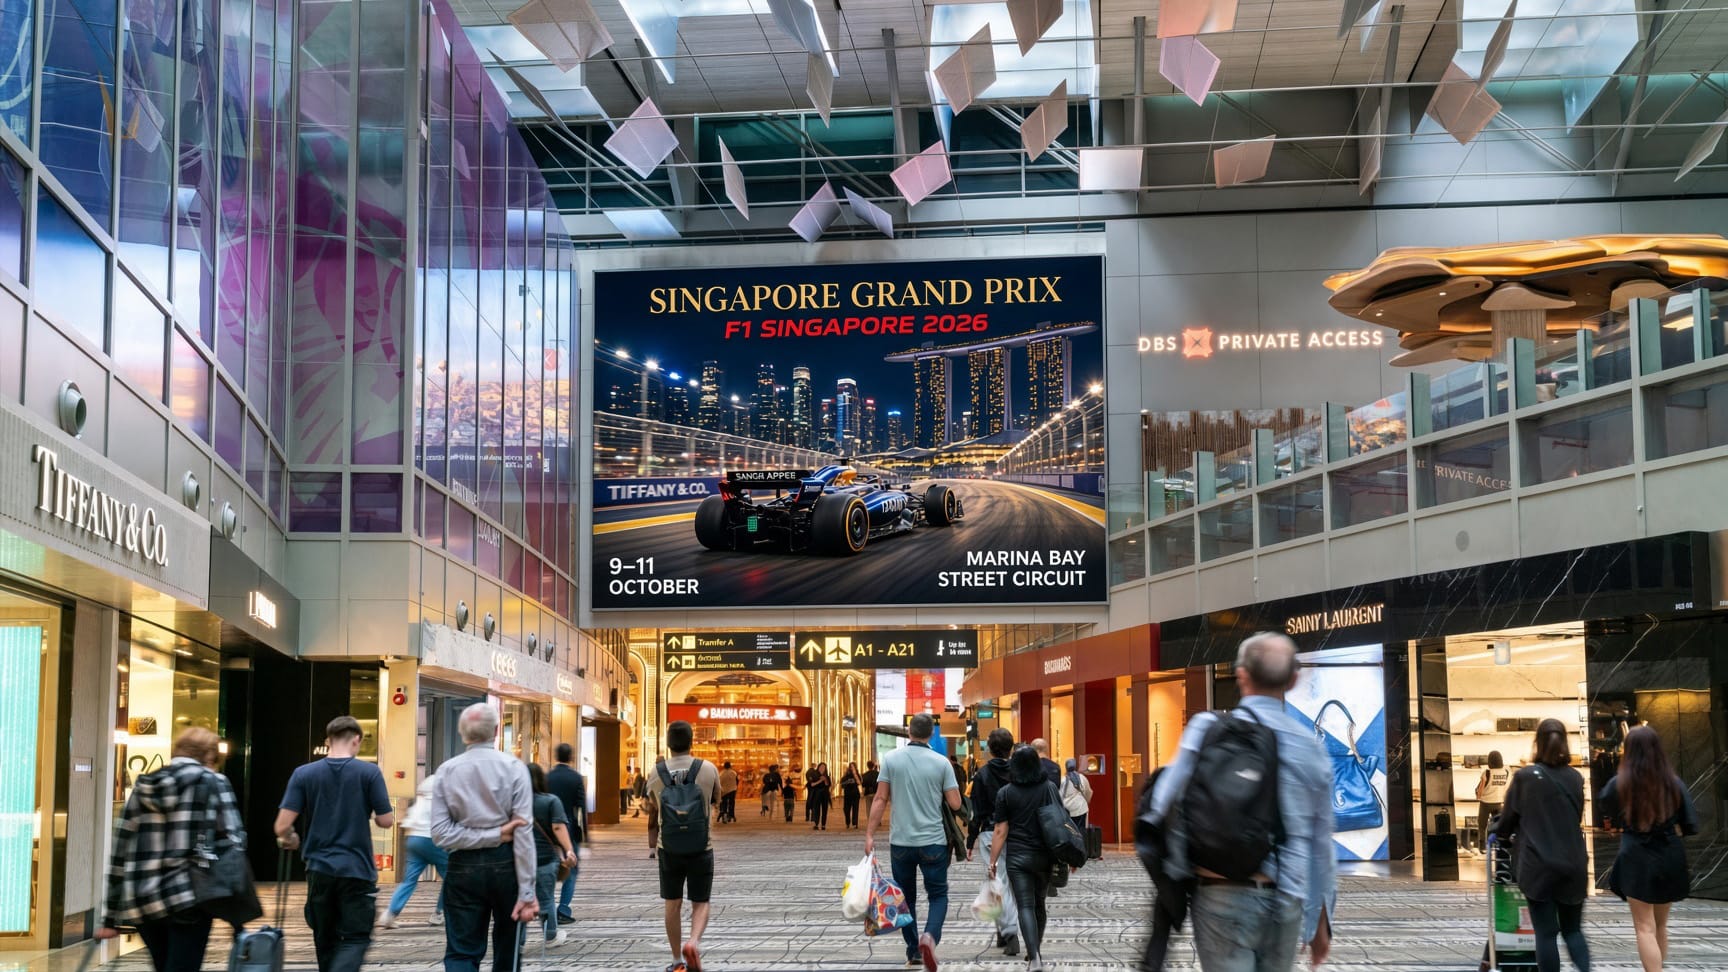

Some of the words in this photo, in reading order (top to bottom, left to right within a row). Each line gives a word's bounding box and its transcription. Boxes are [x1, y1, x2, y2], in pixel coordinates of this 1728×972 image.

[650, 283, 841, 314] SINGAPORE
[851, 279, 973, 308] GRAND
[984, 276, 1063, 305] PRIX
[725, 320, 752, 339] F1
[760, 316, 915, 338] SINGAPORE
[922, 314, 989, 334] 2026
[1138, 336, 1177, 352] DBS
[1218, 332, 1300, 350] PRIVATE
[1308, 330, 1383, 347] ACCESS
[607, 483, 676, 500] TIFFANY
[967, 550, 1043, 566] MARINA
[1049, 550, 1086, 566] BAY
[609, 578, 699, 595] OCTOBER
[938, 571, 1008, 587] STREET
[1012, 570, 1087, 587] CIRCUIT
[1323, 603, 1385, 630] LAURENT
[727, 638, 734, 647] A
[854, 643, 873, 657] A1
[887, 643, 915, 657] A21
[739, 708, 769, 719] COFFEE
